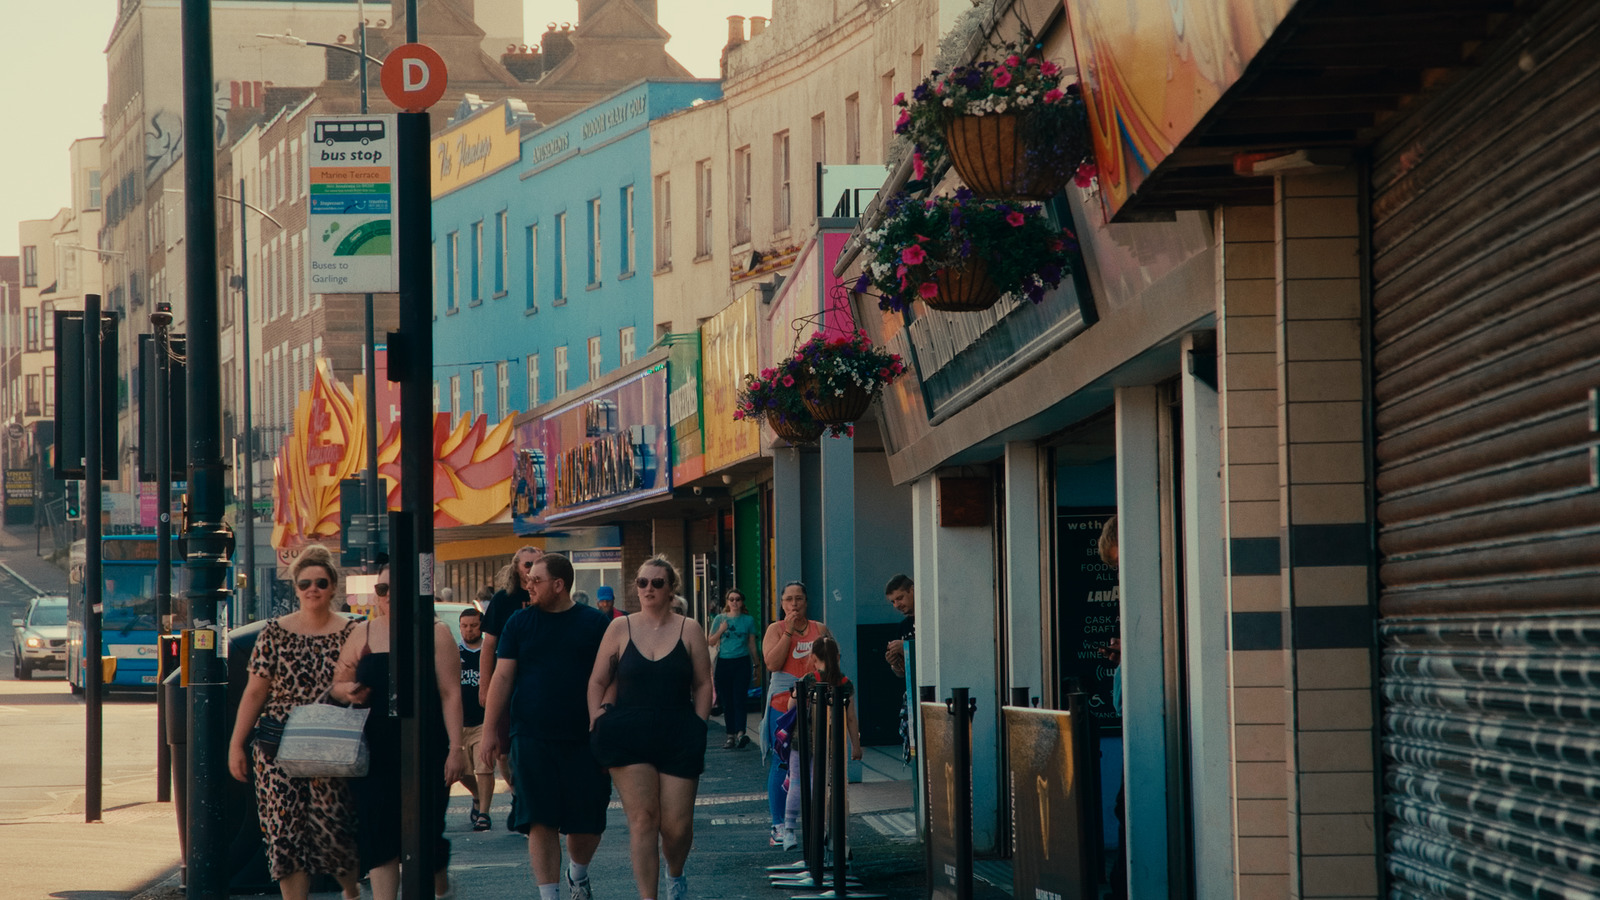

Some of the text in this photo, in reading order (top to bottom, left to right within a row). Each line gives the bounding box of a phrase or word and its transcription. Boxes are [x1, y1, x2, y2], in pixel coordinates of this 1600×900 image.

[403, 58, 430, 92] D
[583, 113, 607, 141] INDOOR
[630, 94, 647, 120] GOLF
[533, 132, 570, 165] AMUSEMENTS
[321, 150, 382, 163] bus stop
[321, 171, 379, 179] Marine Terrace
[312, 261, 348, 270] Buses to
[312, 274, 348, 286] Garlinge
[1081, 563, 1109, 572] FOOD
[1096, 572, 1114, 580] ALL
[1085, 616, 1112, 625] CASK
[1083, 625, 1116, 634] CRAFT
